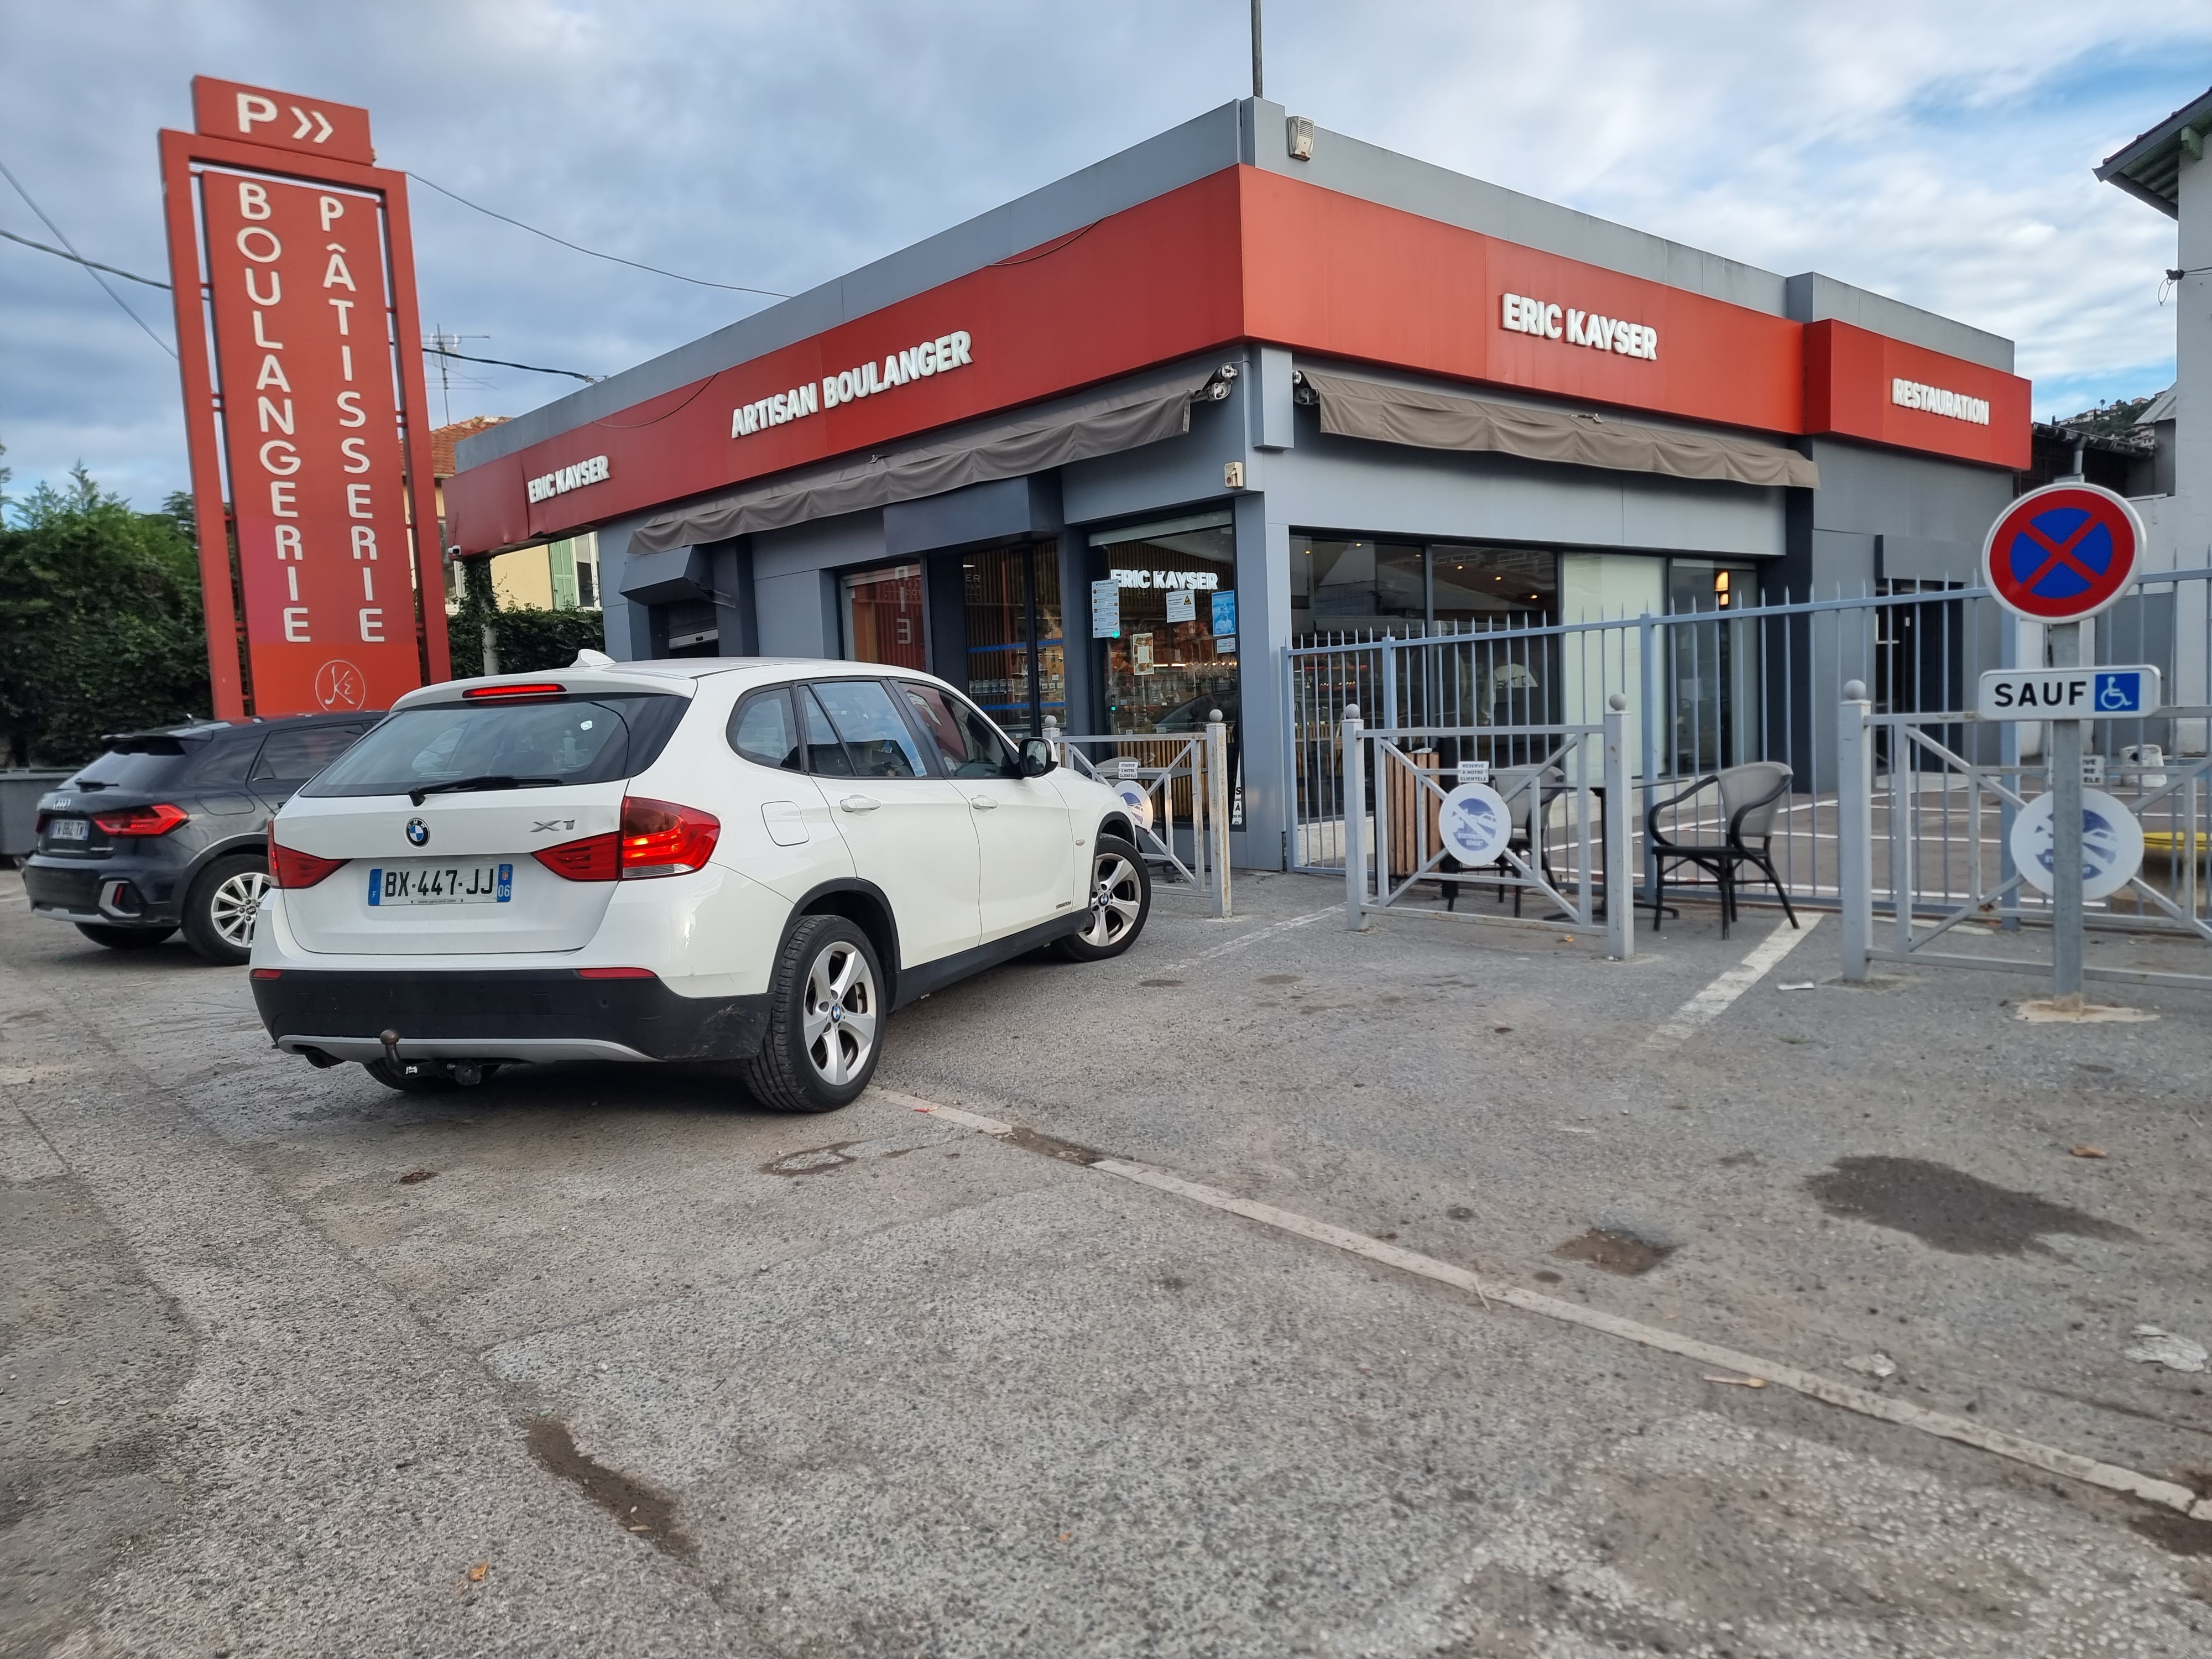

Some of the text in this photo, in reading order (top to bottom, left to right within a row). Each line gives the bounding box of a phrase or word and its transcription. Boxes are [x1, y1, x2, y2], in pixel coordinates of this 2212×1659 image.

[236, 92, 278, 133] P
[1502, 293, 1657, 361] ERIC KAYSER
[731, 331, 973, 439] ARTISAN BOULANGER
[1892, 378, 1990, 425] RESTAURATION
[236, 182, 311, 643] BOULANGERIE
[320, 195, 385, 643] PÂTISSERIE
[528, 455, 611, 504] ERIC KAYSER
[1110, 570, 1218, 590] ERIC KAYSER
[1994, 681, 2086, 707] SAUF
[530, 818, 576, 833] X1
[384, 868, 494, 898] BX-447-JJ
[498, 884, 510, 898] 06
